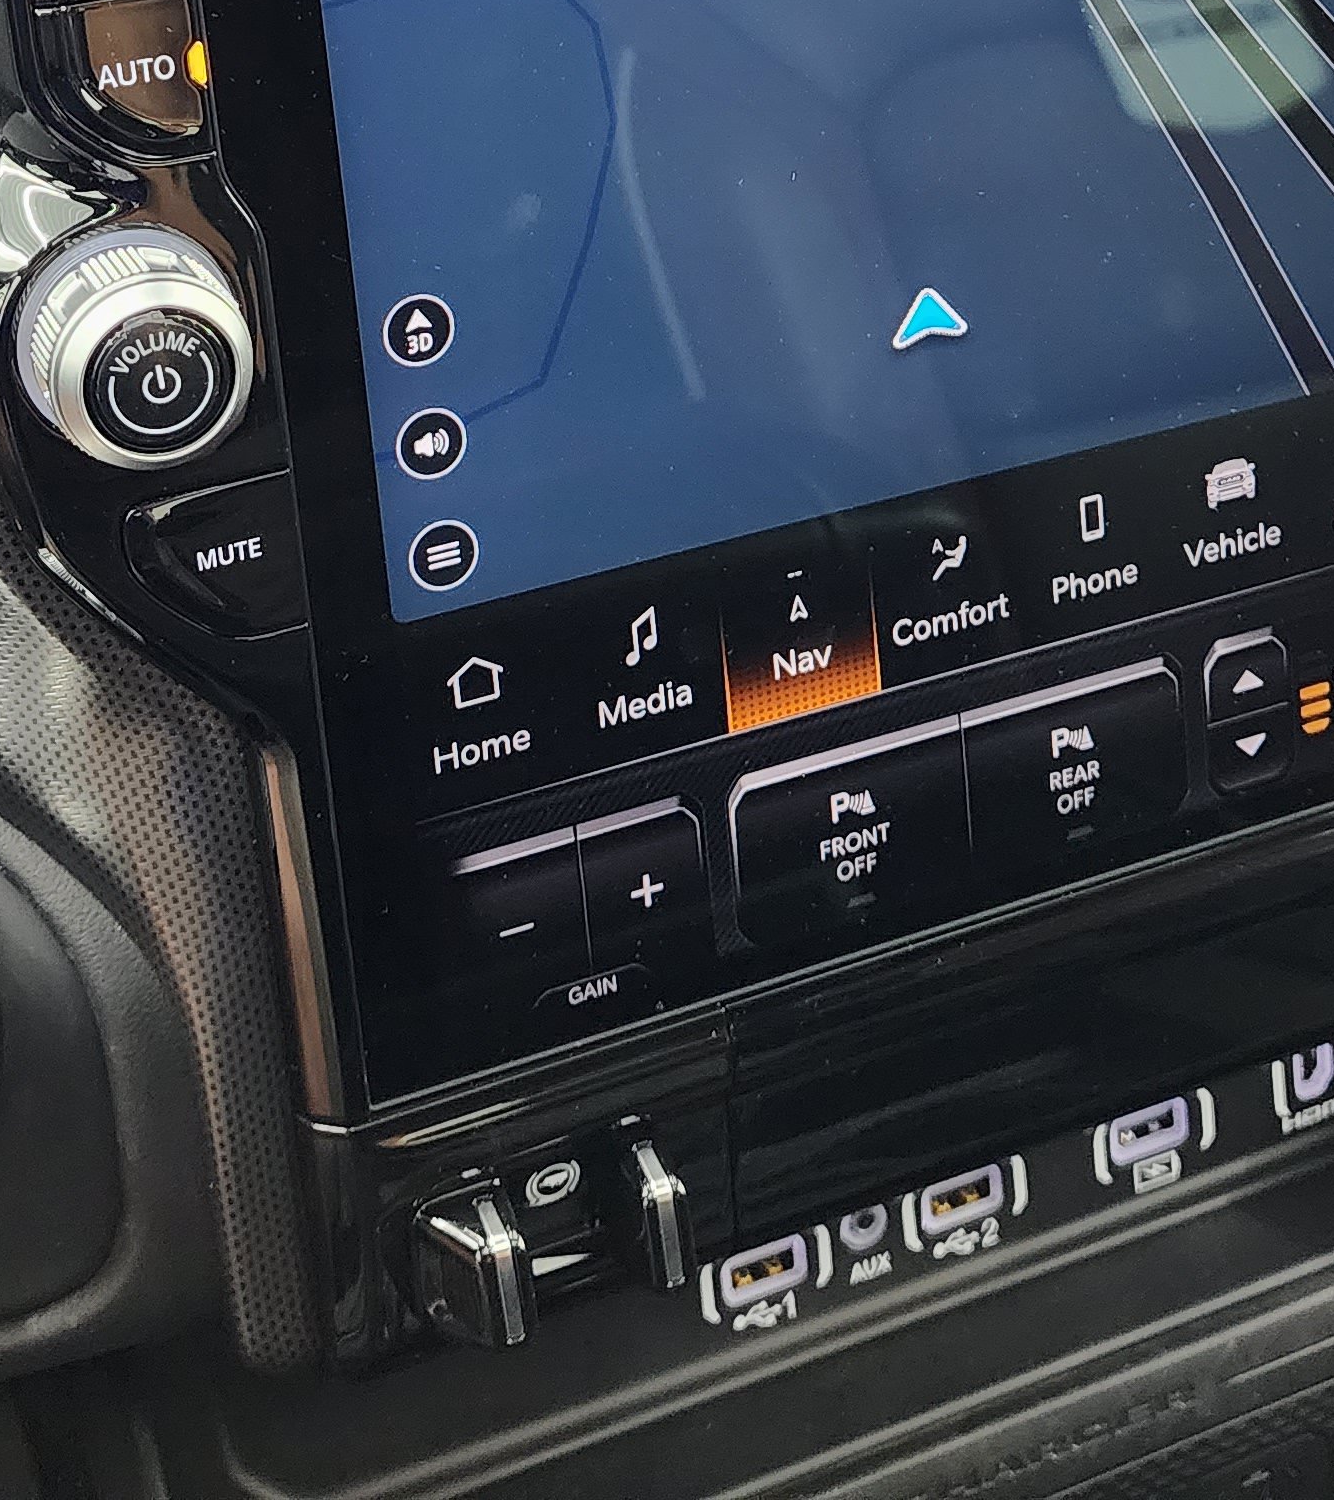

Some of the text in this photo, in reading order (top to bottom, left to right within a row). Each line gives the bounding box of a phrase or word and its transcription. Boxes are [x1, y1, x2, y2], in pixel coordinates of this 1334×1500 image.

[97, 53, 176, 90] AUTO
[109, 331, 201, 376] VOLUME
[405, 332, 434, 356] 3D
[196, 536, 263, 573] MUTE
[1183, 522, 1283, 568] Vehicle
[1052, 560, 1140, 604] Phone
[892, 593, 1010, 647] Comfort
[772, 643, 833, 682] Nav
[597, 681, 694, 730] Media
[433, 726, 532, 775] Home
[1049, 759, 1101, 792] REAR
[1056, 785, 1095, 815] OFF
[819, 821, 891, 862] FRONT
[836, 851, 877, 882] OFF
[568, 974, 618, 1006] GAIN
[849, 1250, 894, 1286] AUX
